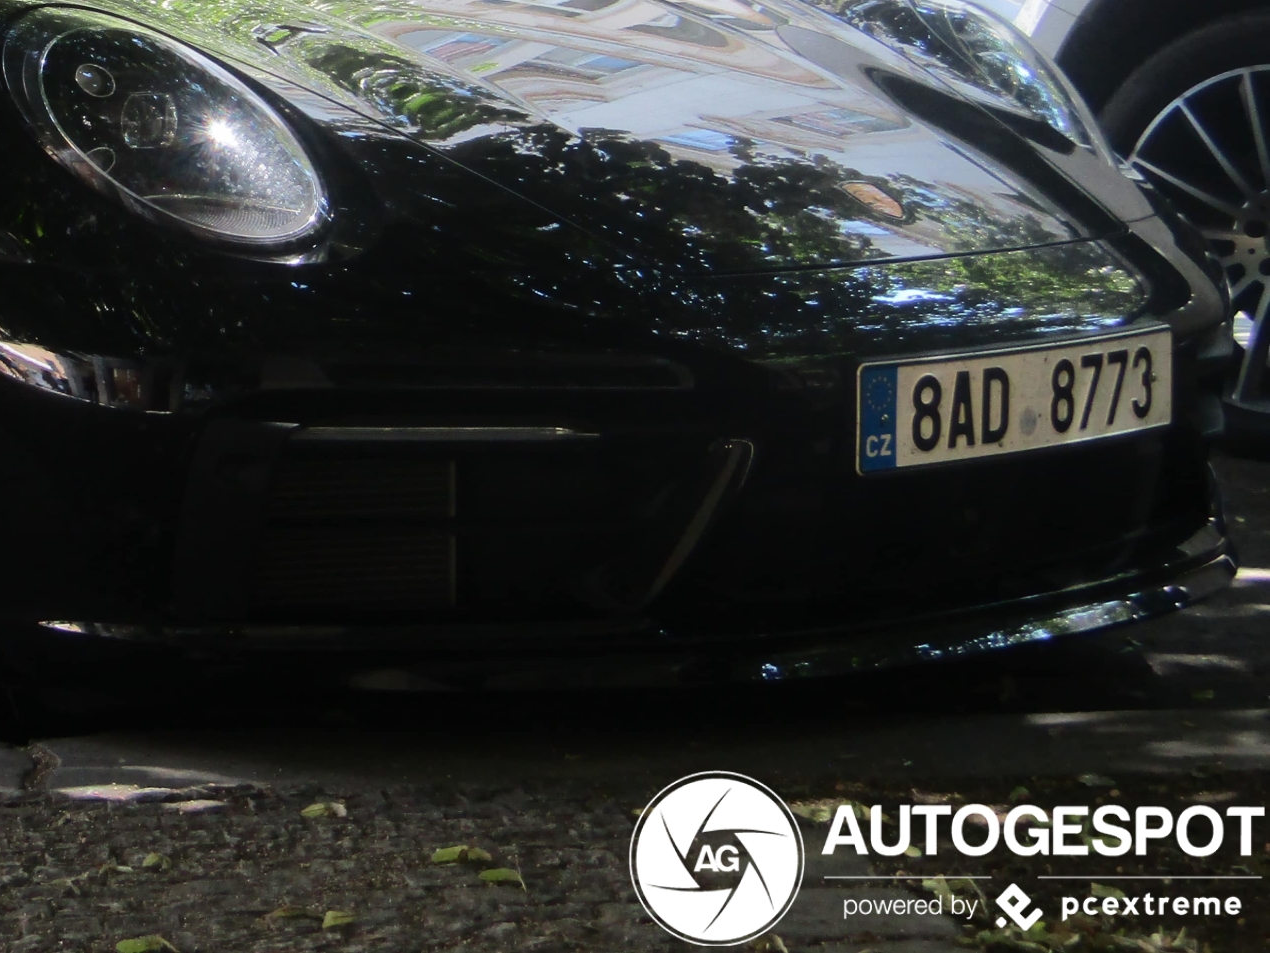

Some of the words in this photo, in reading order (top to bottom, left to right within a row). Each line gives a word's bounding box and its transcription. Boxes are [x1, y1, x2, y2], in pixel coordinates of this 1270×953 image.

[911, 366, 1010, 452] 8AD
[1050, 346, 1153, 434] 8773
[866, 434, 892, 458] CZ
